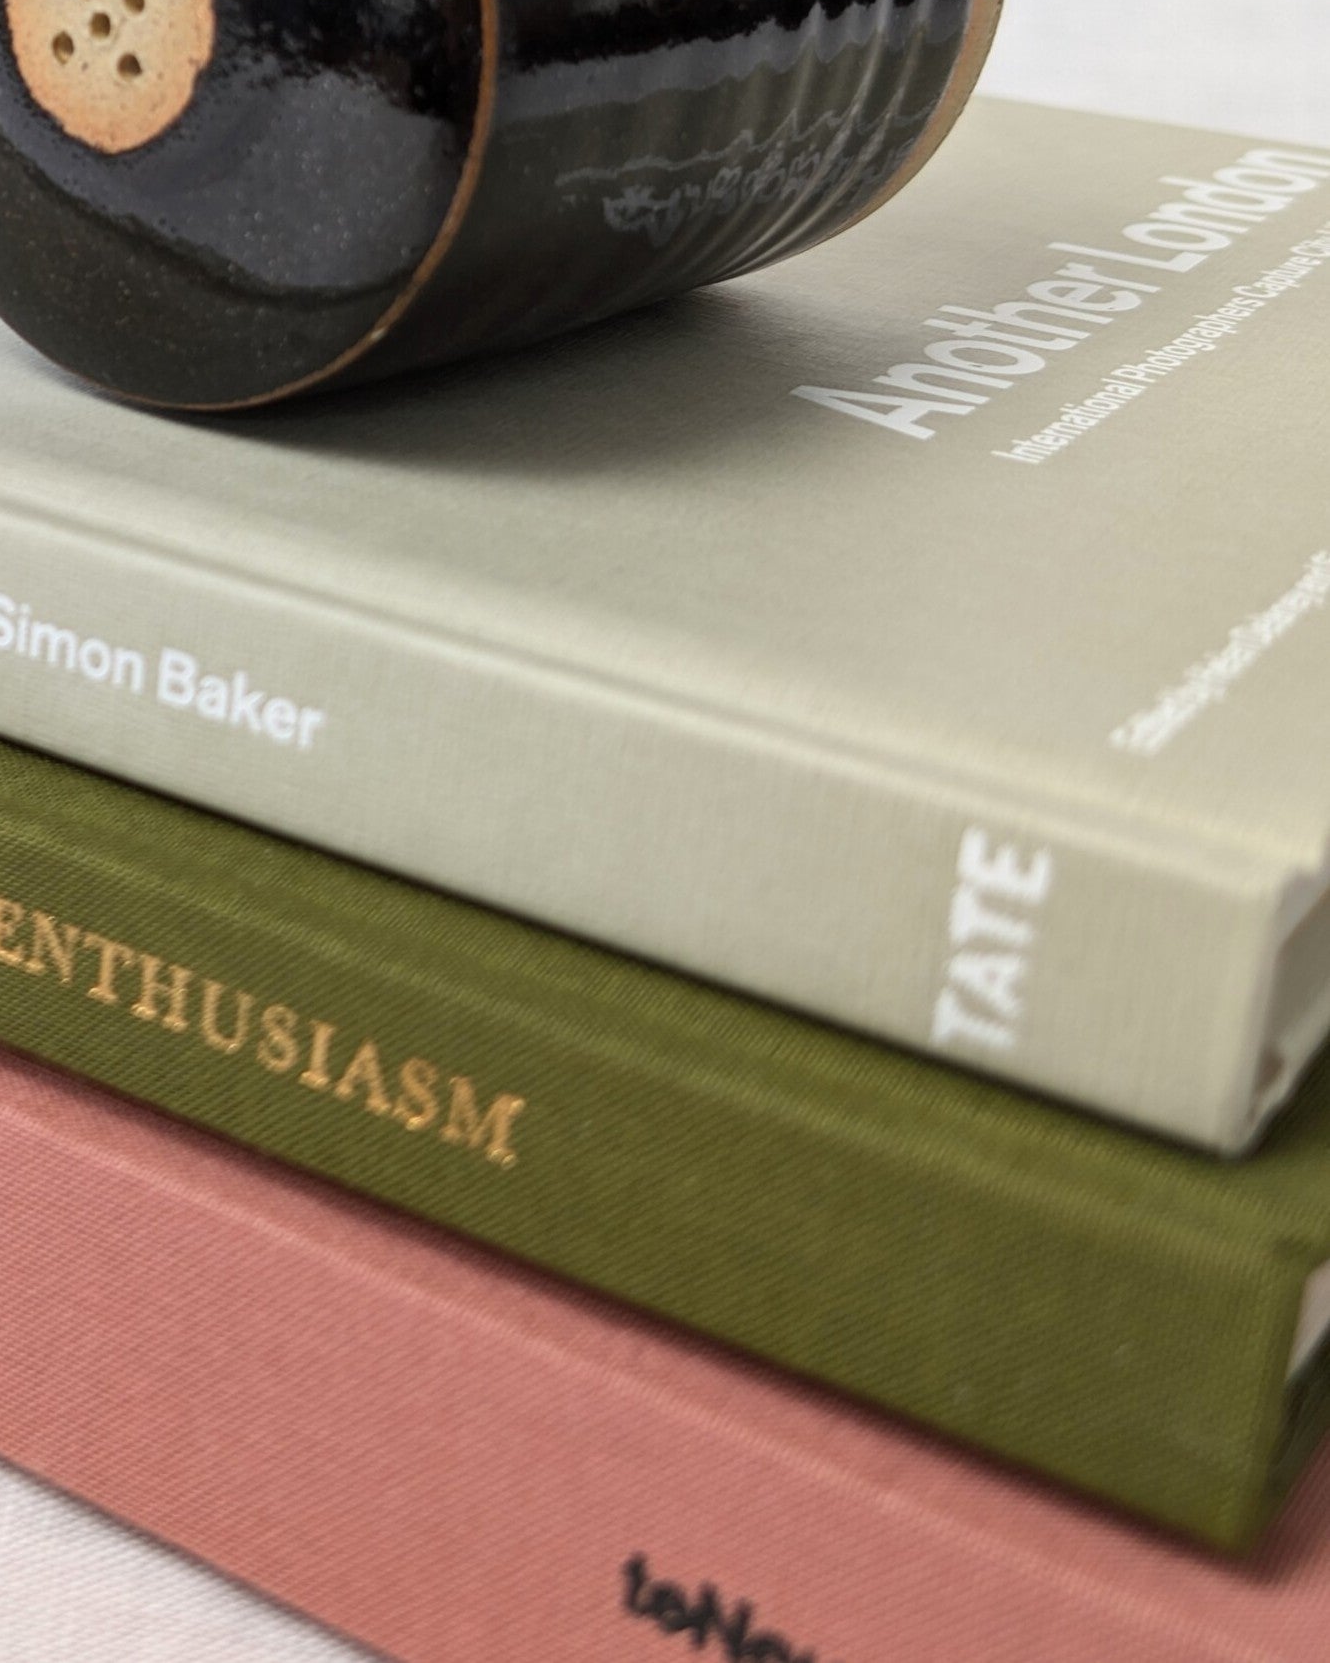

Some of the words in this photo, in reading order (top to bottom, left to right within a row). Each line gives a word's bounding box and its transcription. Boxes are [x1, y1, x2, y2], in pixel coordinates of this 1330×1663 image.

[789, 260, 1162, 441] Another
[1046, 147, 1330, 274] London
[990, 378, 1148, 465] International
[1109, 296, 1266, 384] Photographers
[1231, 254, 1322, 300] Capture
[156, 645, 327, 751] Baker
[930, 824, 1054, 1048] TATE
